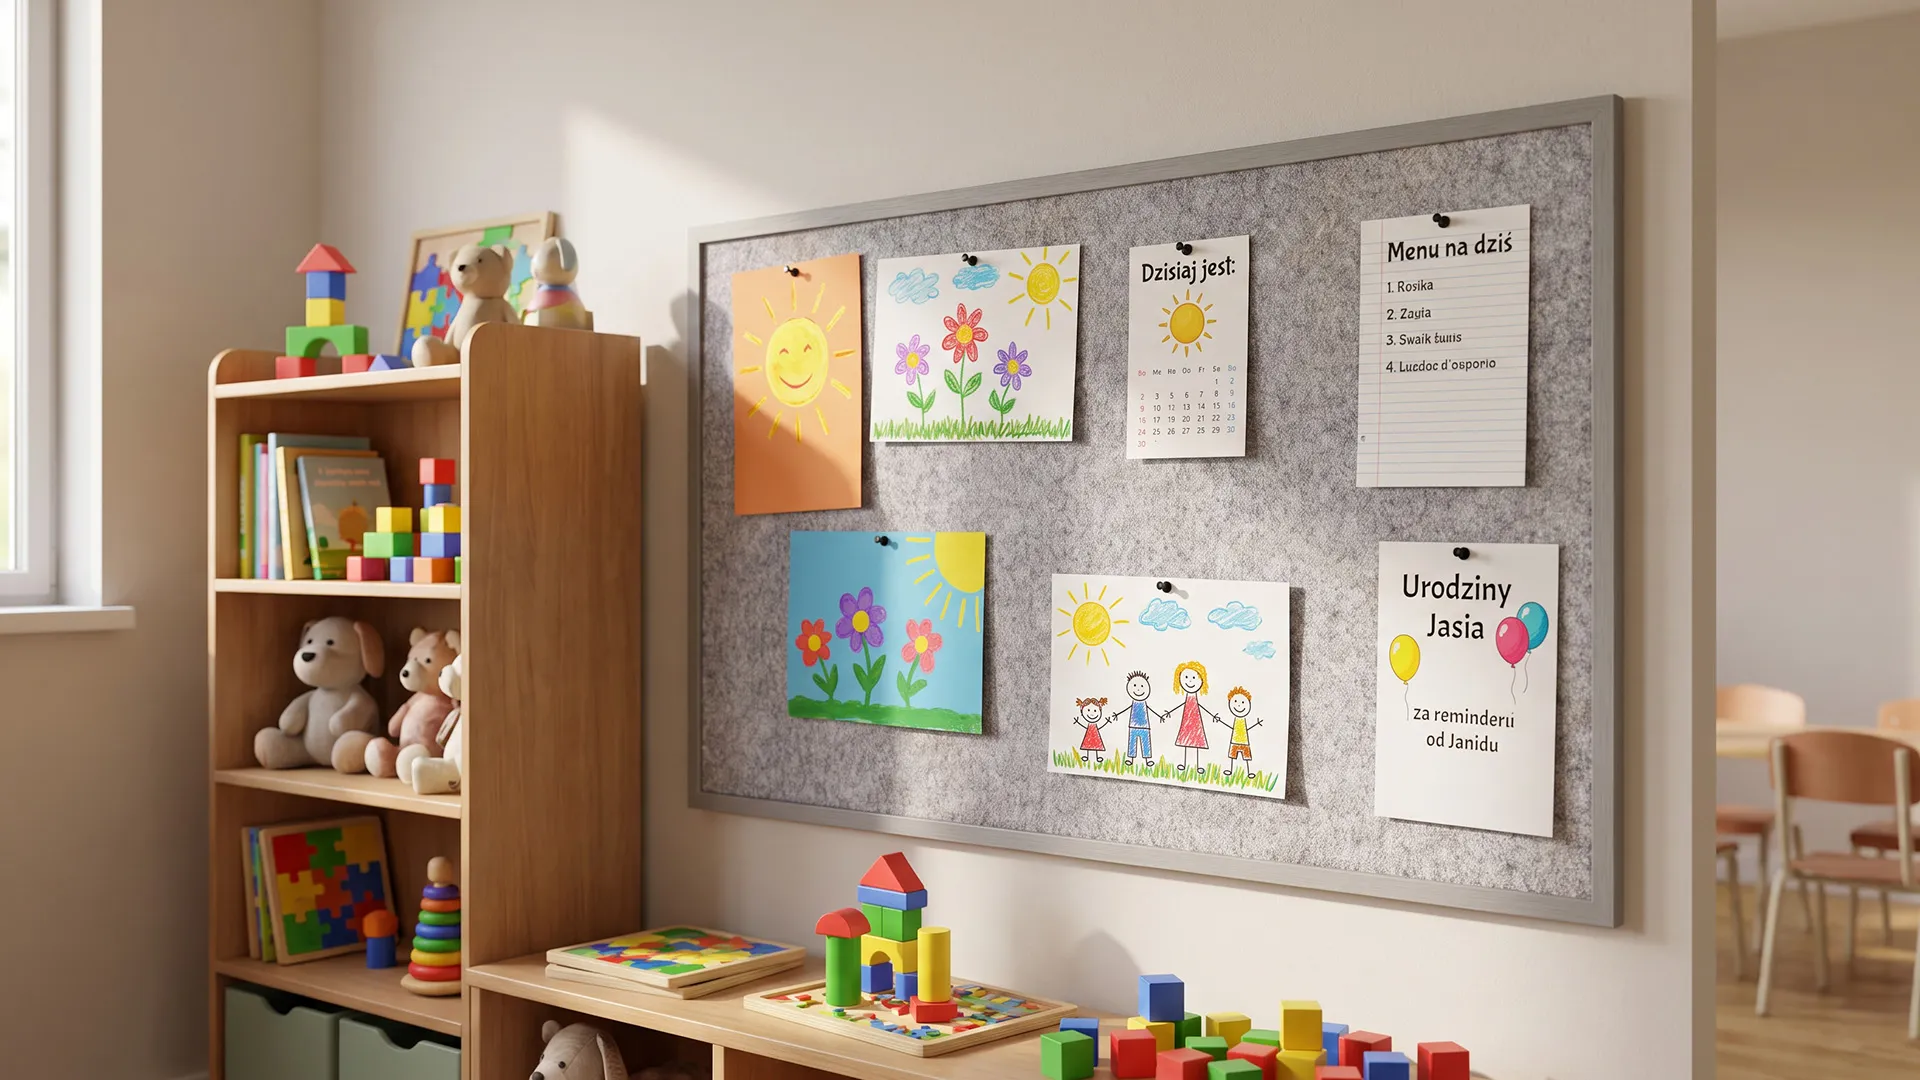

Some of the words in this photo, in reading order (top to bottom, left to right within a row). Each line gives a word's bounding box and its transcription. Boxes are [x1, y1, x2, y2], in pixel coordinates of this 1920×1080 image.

[1388, 242, 1438, 262] Menu
[1446, 242, 1467, 256] na
[1475, 232, 1512, 254] dziś
[1142, 261, 1196, 285] Dzisiaj
[1200, 256, 1235, 283] jest:
[1387, 282, 1394, 293] 1.
[1398, 280, 1433, 292] Rosika
[1387, 309, 1397, 320] 2.
[1386, 335, 1397, 345] 3.
[1400, 334, 1431, 345] Swaik
[1386, 361, 1397, 372] 4.
[1153, 404, 1162, 412] 10
[1168, 403, 1176, 411] 12
[1182, 403, 1191, 411] 13
[1197, 402, 1206, 410] 14
[1212, 402, 1221, 410] 15
[1227, 401, 1236, 409] 16
[1138, 416, 1147, 424] 16
[1153, 416, 1161, 424] 17
[1167, 416, 1176, 424] 19
[1181, 415, 1191, 423] 20
[1197, 415, 1205, 423] 21
[1211, 414, 1221, 422] 22
[1226, 414, 1236, 422] 23
[1137, 428, 1146, 436] 24
[1152, 428, 1161, 436] 25
[1167, 428, 1176, 436] 26
[1181, 427, 1191, 435] 27
[1196, 427, 1206, 435] 25
[1211, 426, 1221, 434] 29
[1226, 426, 1236, 434] 30
[1404, 573, 1511, 608] Urodziny
[1427, 613, 1484, 639] Jasia
[1414, 708, 1429, 720] za
[1427, 731, 1444, 747] od
[1449, 733, 1498, 752] Janidu
